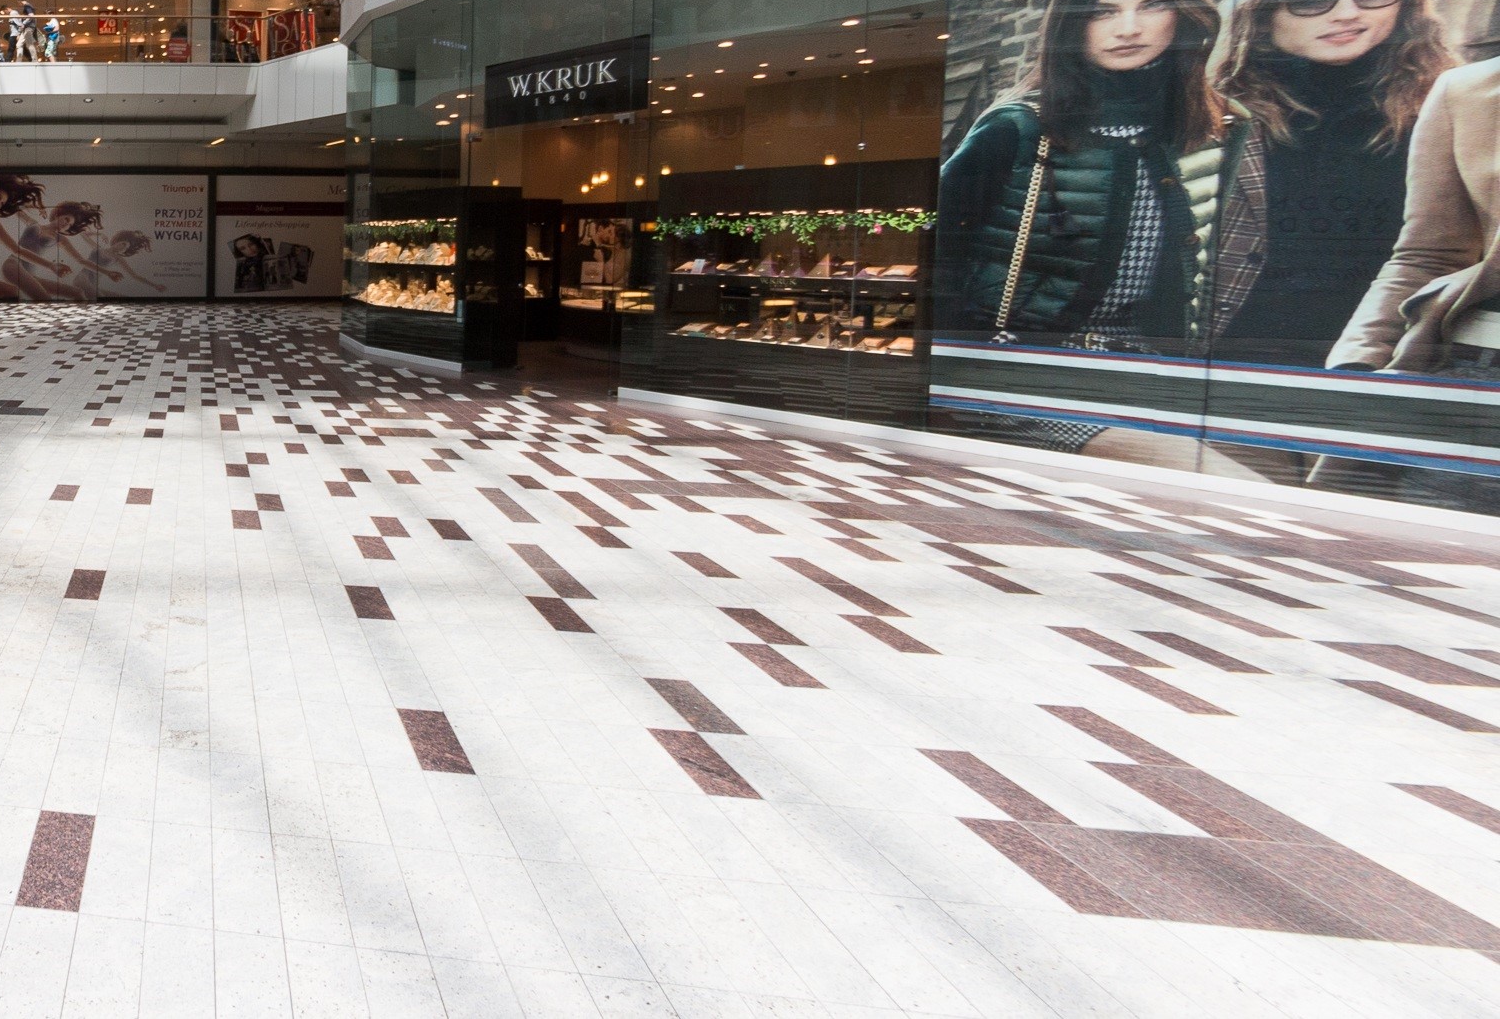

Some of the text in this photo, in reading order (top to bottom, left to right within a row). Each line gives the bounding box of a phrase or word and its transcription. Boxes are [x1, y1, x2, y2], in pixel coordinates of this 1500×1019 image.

[534, 91, 587, 107] 1840
[161, 184, 198, 194] Triumph
[154, 220, 204, 228] PRZYMIERZ
[154, 230, 203, 242] WYGRAJ
